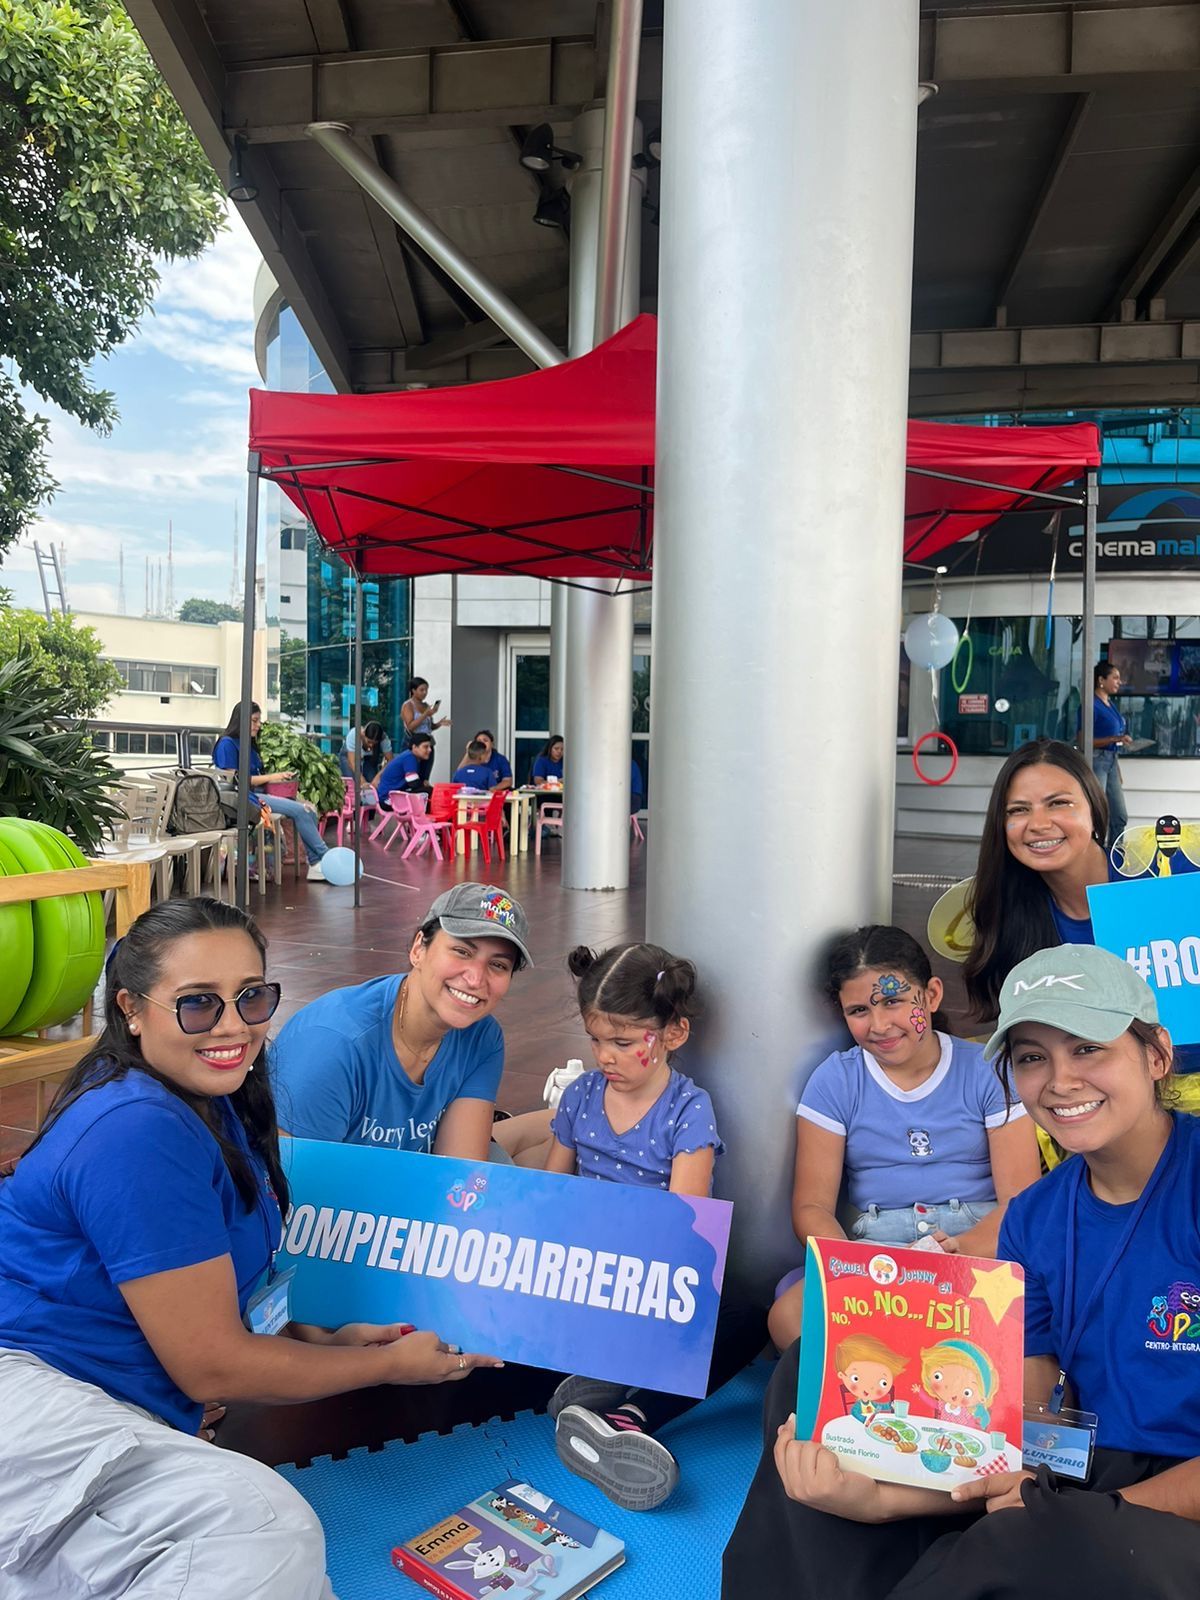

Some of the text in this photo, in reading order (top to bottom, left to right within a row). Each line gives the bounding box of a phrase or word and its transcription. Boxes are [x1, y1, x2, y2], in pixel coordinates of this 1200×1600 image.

[1013, 973, 1085, 996] MK
[829, 1256, 869, 1278] RAQUEL
[897, 1267, 938, 1286] JOHNNY
[831, 1311, 851, 1325] NO,
[843, 1295, 873, 1317] NO,
[1022, 1447, 1086, 1468] LUNTARIO
[415, 1522, 469, 1556] Emma
